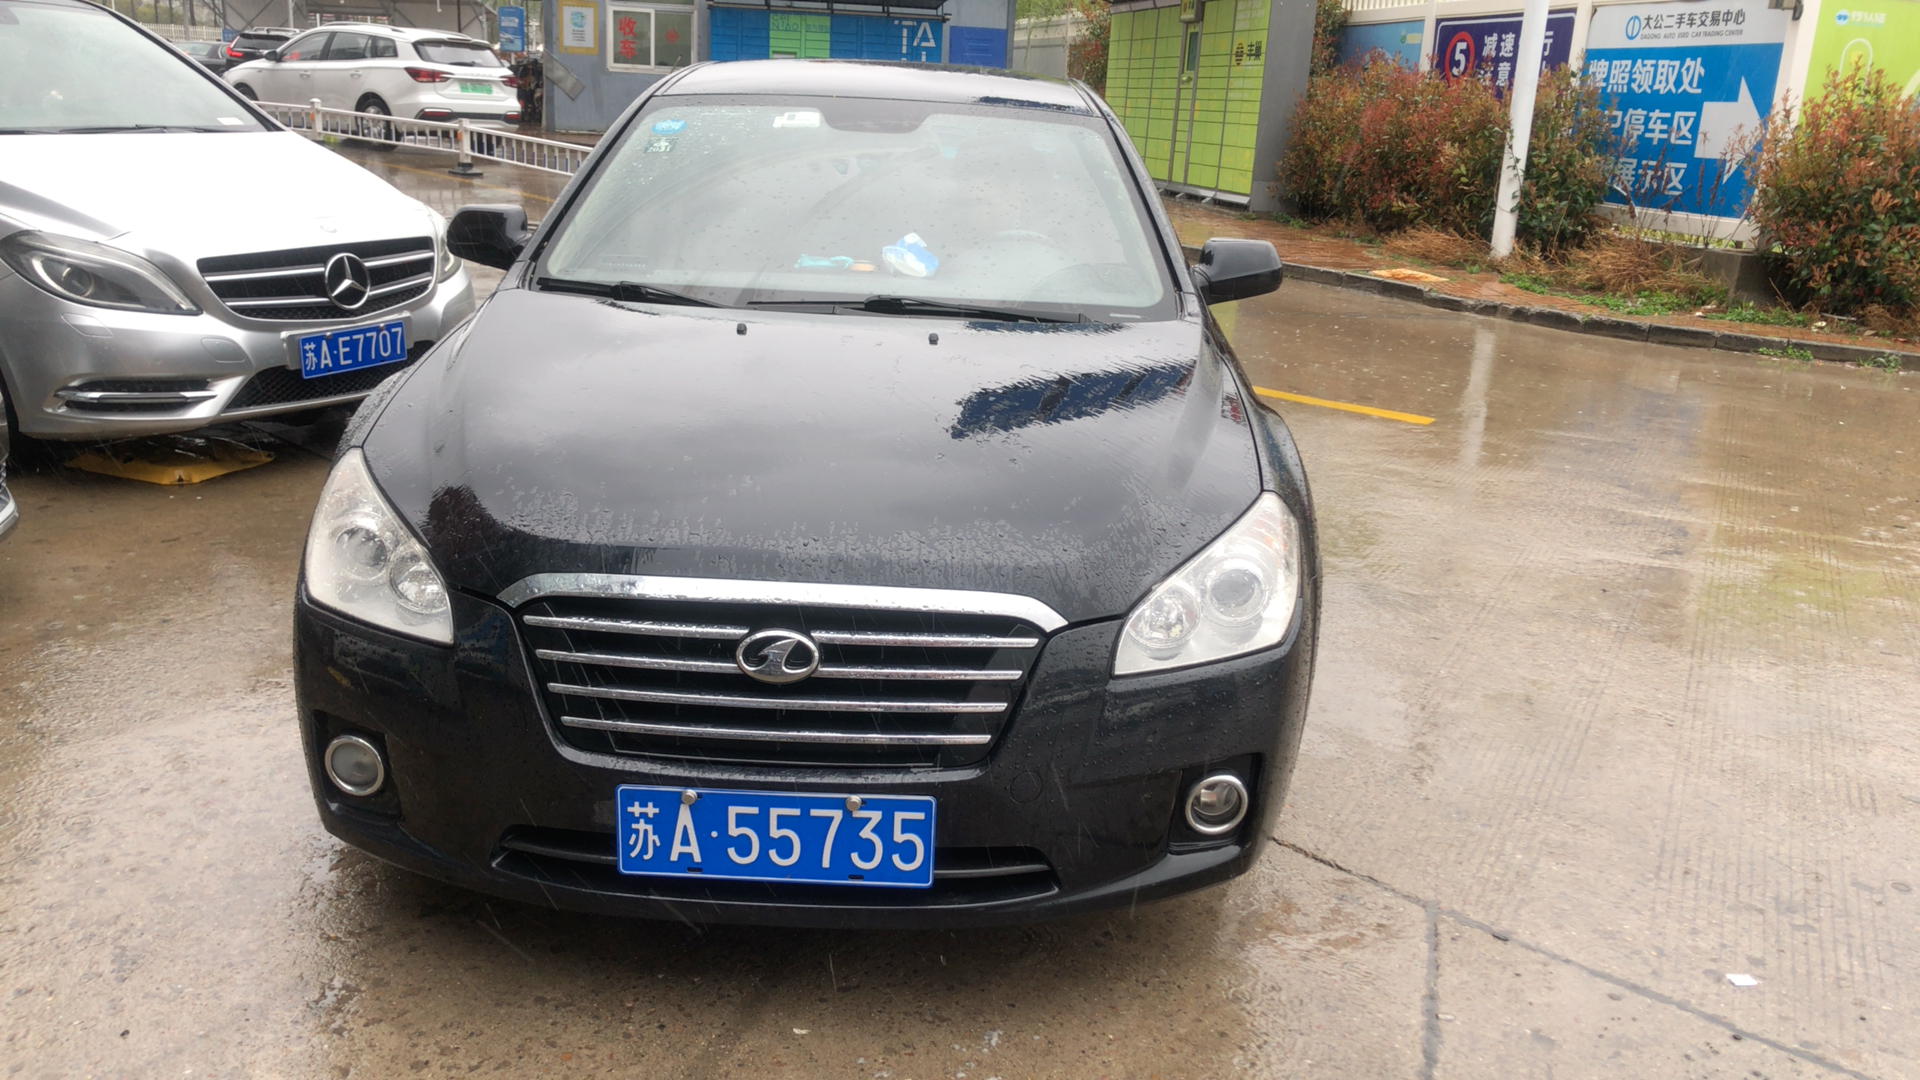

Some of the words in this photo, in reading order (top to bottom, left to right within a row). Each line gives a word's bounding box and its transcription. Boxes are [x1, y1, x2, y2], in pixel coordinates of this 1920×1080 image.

[618, 16, 637, 59] 收车
[1642, 9, 1745, 30] 大公二手车交易中心
[1677, 31, 1689, 39] USED
[1702, 29, 1724, 38] TRADING
[1247, 40, 1262, 61] 丰巢
[1452, 42, 1468, 76] 5
[1588, 57, 1705, 95] 牌照领取处
[303, 326, 402, 371] 苏A·E7707
[626, 801, 925, 872] 苏A·55735
